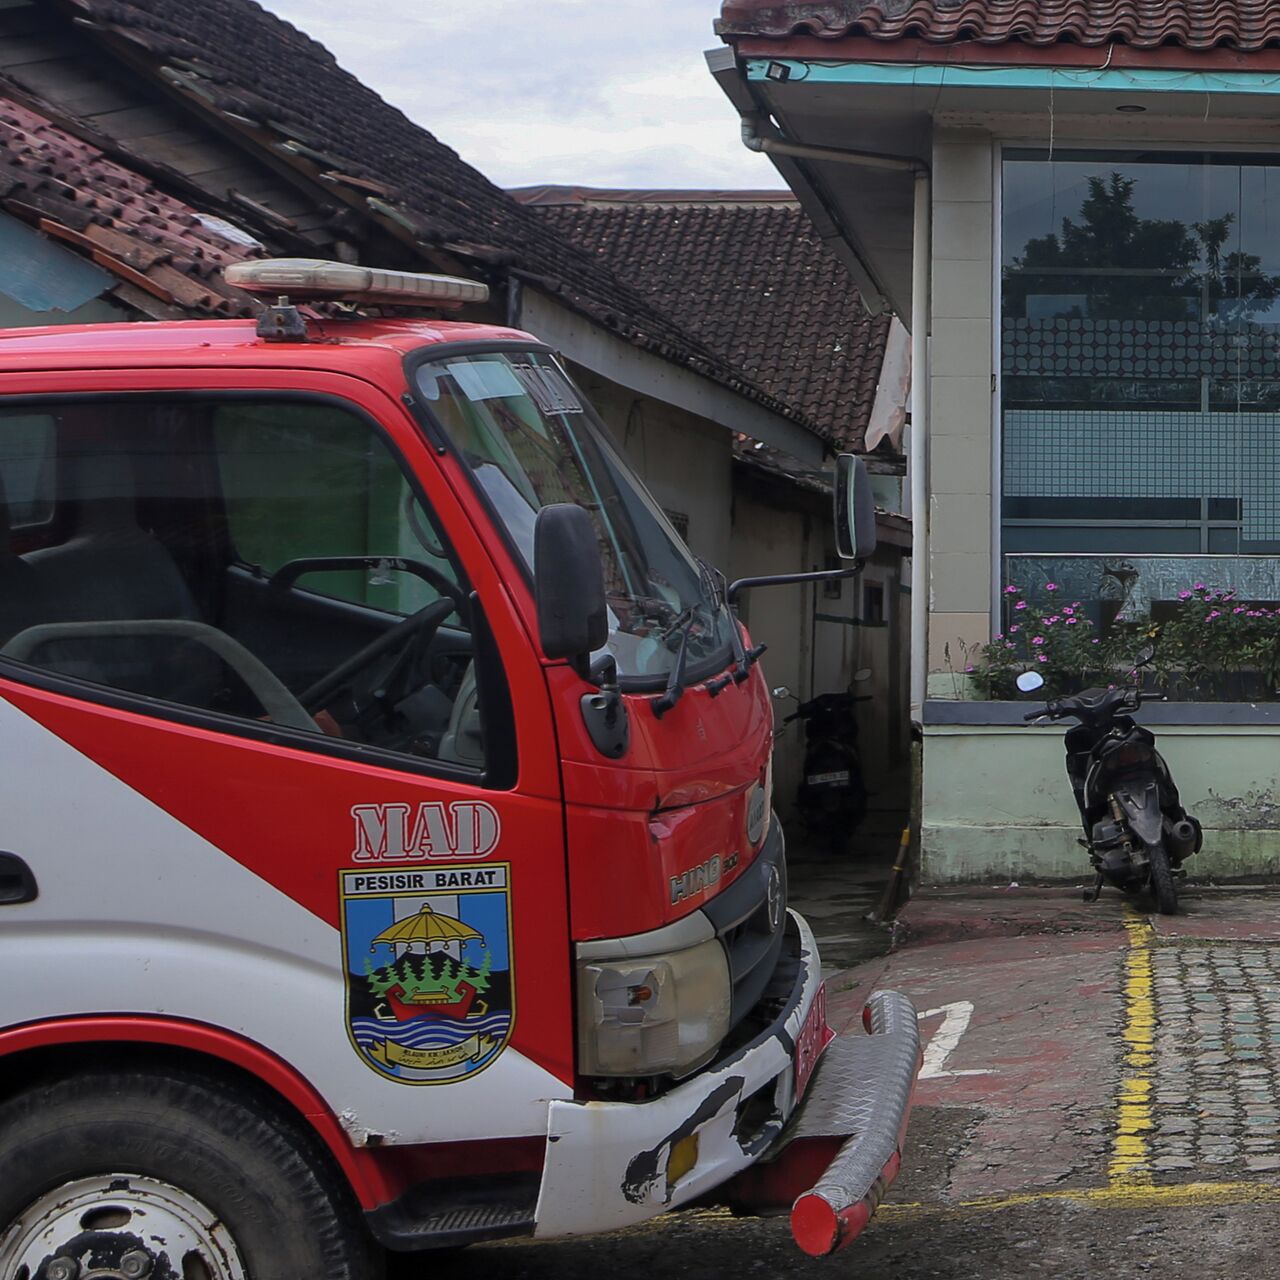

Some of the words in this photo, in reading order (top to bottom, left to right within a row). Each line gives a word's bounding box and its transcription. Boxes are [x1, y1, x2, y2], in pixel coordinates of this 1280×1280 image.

[351, 800, 501, 862] MAD
[354, 874, 425, 891] PESISIR
[435, 870, 496, 887] BARAT
[669, 853, 721, 906] HINO
